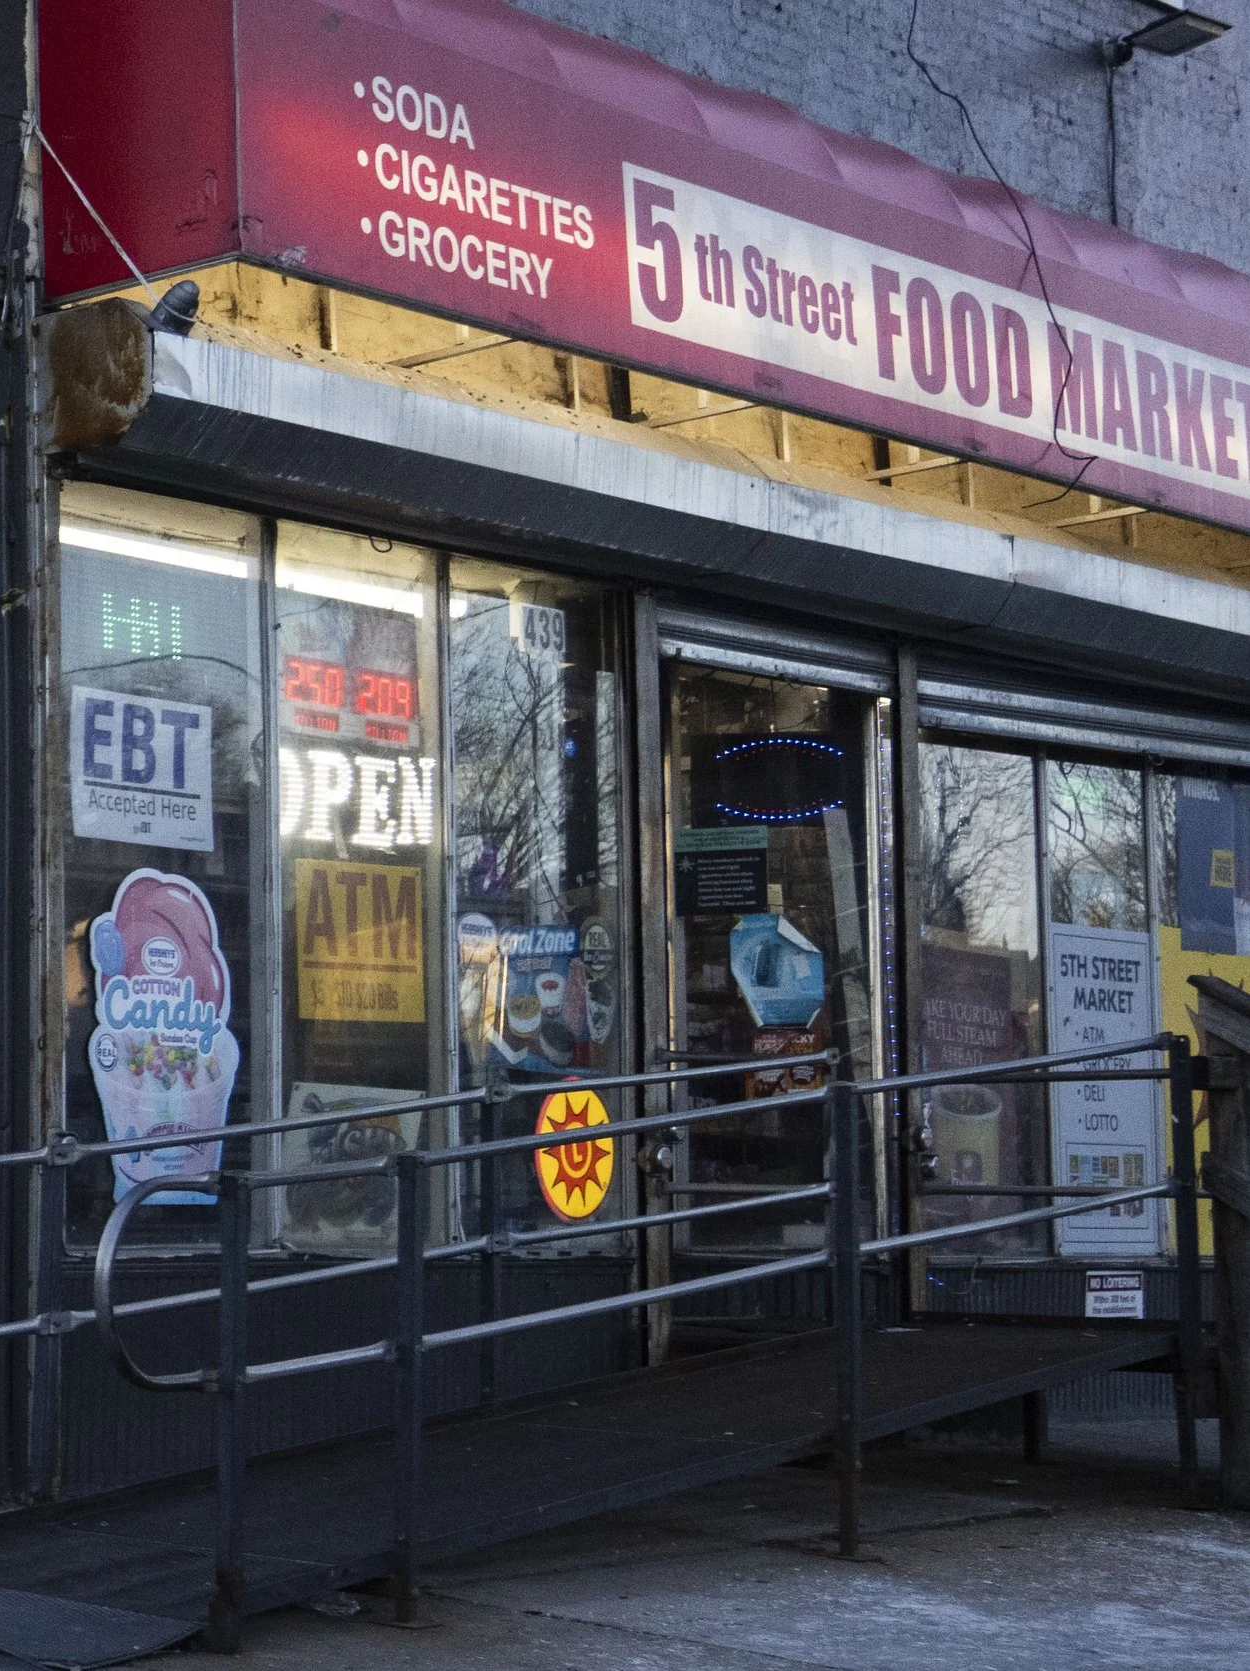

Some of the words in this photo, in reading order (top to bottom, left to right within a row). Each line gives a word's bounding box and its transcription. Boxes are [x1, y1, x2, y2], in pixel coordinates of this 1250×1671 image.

[371, 75, 475, 150] SODA
[375, 143, 595, 249] CIGARETTES
[378, 210, 553, 299] GROCERY
[742, 244, 858, 346] Street
[871, 263, 1033, 419] FOOD
[525, 608, 564, 651] 439
[83, 697, 200, 790] EBT
[88, 789, 156, 818] Accepted
[161, 798, 198, 821] Here
[303, 869, 418, 960] ATM
[536, 928, 576, 953] Zone
[1060, 953, 1088, 979] 5TH
[1091, 956, 1141, 984] STREET
[132, 979, 182, 997] COTTON
[1073, 985, 1134, 1015] MARKET
[105, 979, 222, 1055] Candy
[1082, 1026, 1105, 1044] ATM
[96, 1047, 117, 1058] REAL
[1084, 1084, 1106, 1102] DELI
[1085, 1113, 1119, 1132] LOTTO
